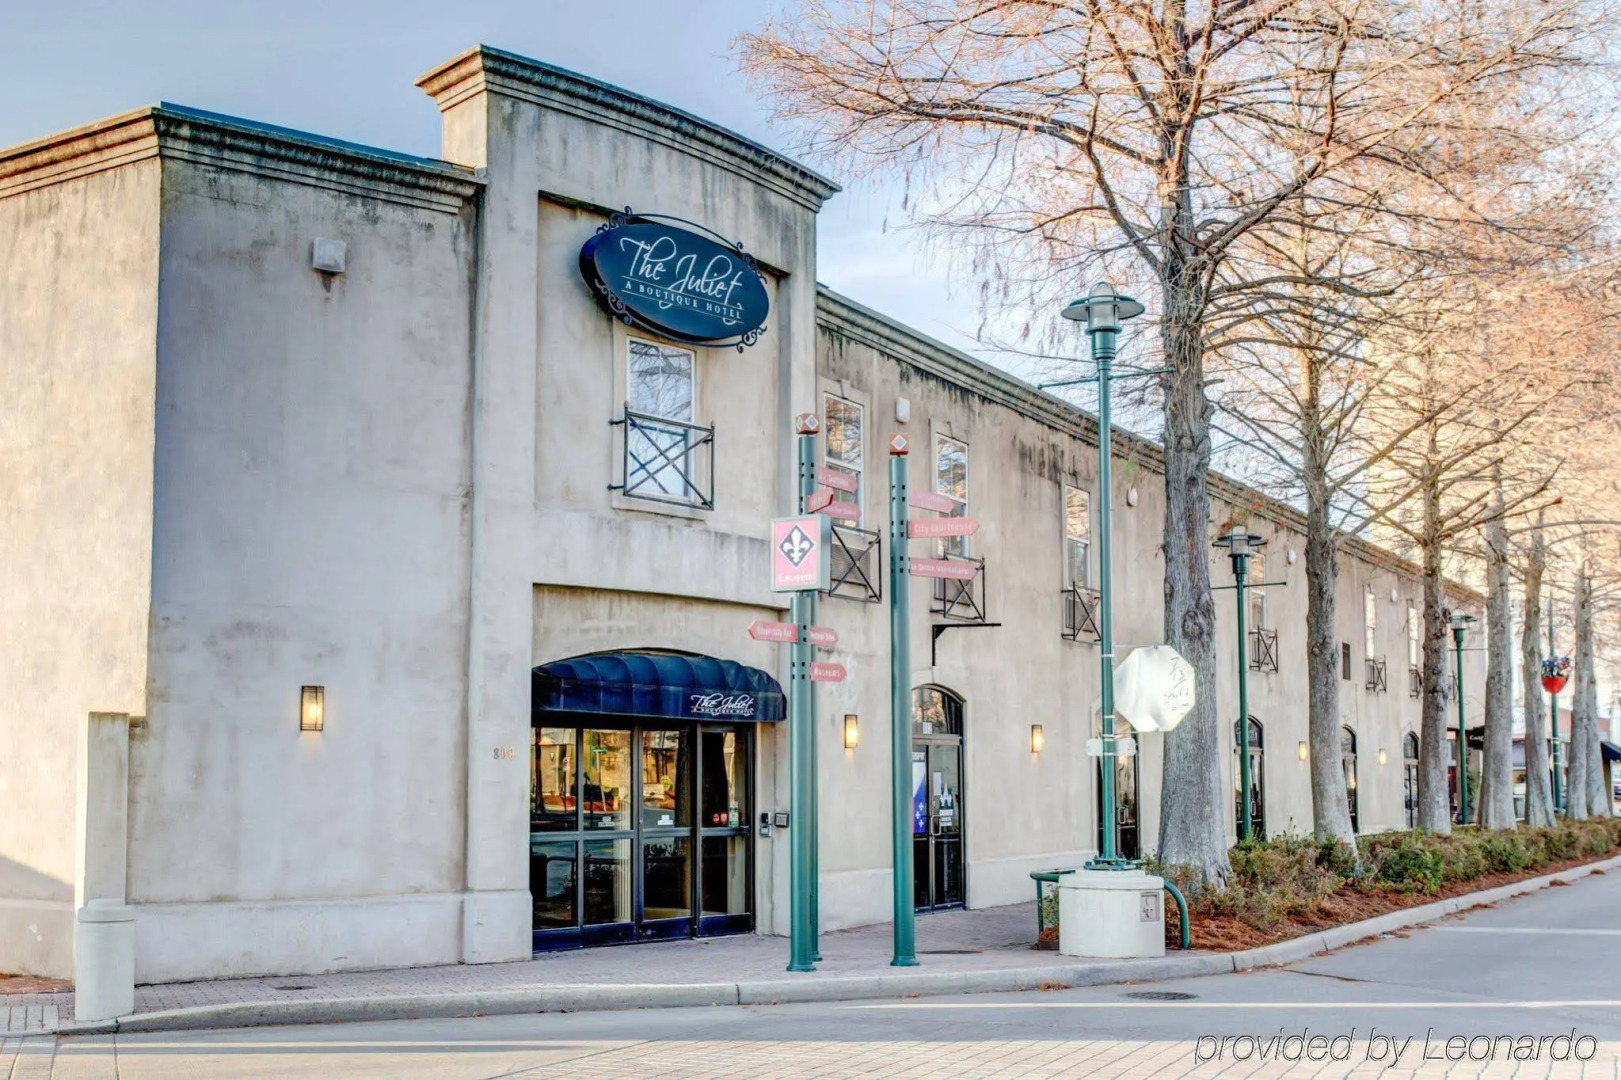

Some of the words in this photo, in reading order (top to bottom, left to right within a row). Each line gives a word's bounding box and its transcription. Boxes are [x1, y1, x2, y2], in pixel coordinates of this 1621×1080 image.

[620, 236, 677, 282] The
[660, 254, 743, 317] Juliet
[625, 280, 632, 290] A
[639, 284, 699, 308] BOUTIQUE
[706, 303, 742, 319] HOTEL
[690, 693, 724, 708] The
[713, 694, 755, 714] Juliet
